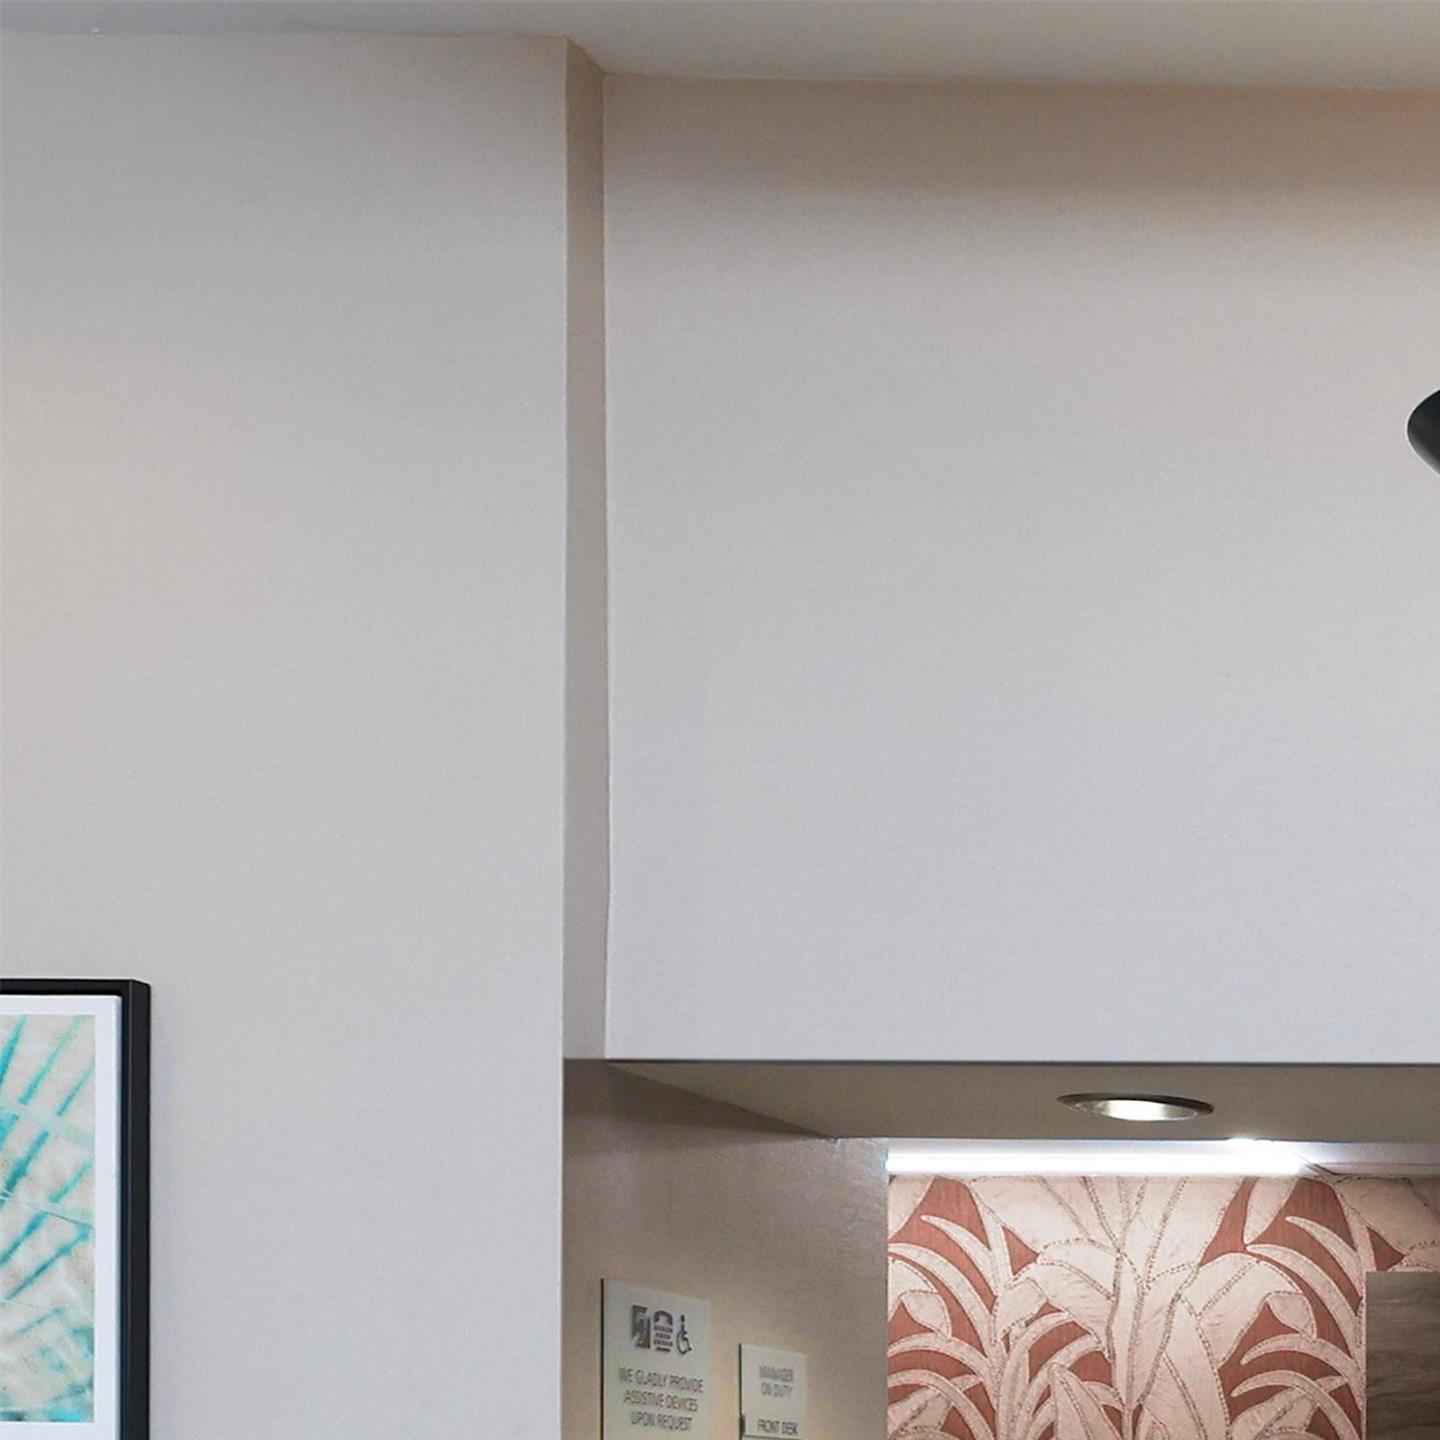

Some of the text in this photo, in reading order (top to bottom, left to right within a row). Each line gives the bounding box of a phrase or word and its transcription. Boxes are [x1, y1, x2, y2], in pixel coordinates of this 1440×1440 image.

[618, 1367, 704, 1393] WE GLADLY PROVIDE
[624, 1390, 699, 1412] ASSISTIVE DEVICES
[631, 1411, 693, 1431] UPON REQUEST
[757, 1419, 798, 1435] FRONT DESK
